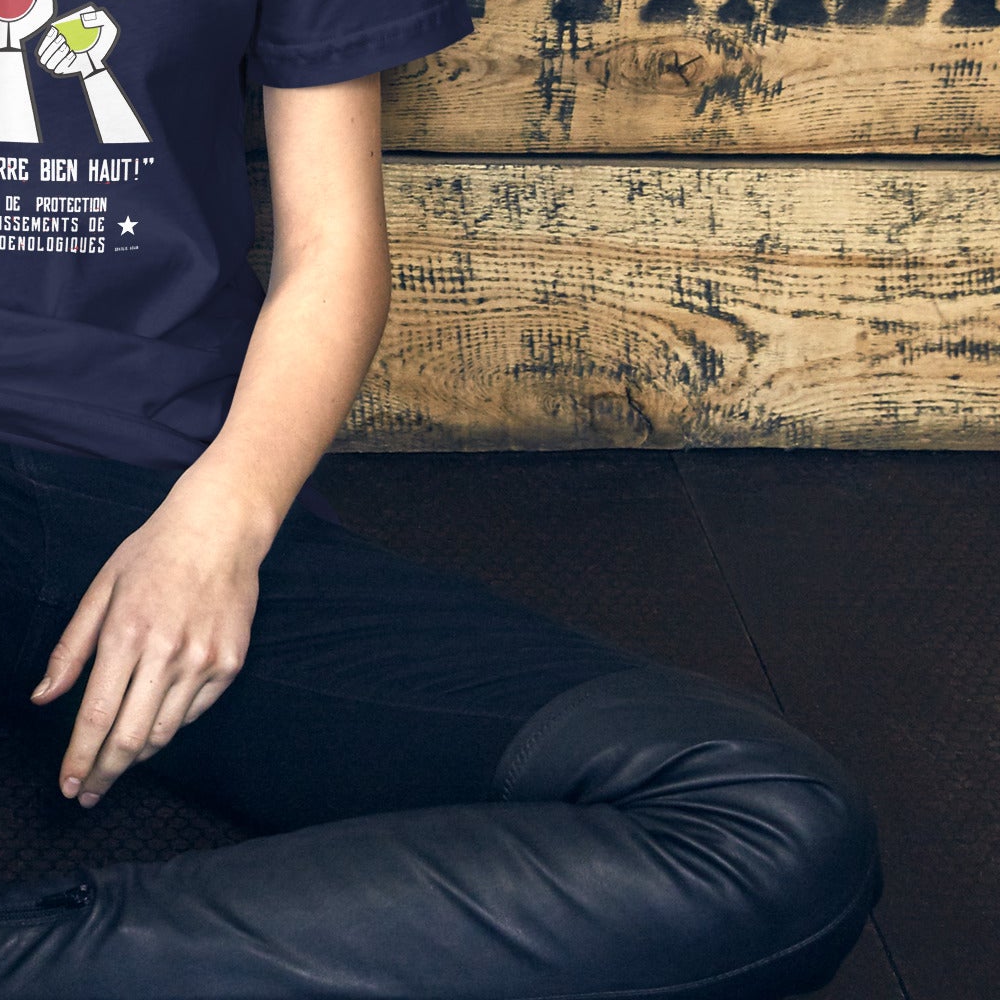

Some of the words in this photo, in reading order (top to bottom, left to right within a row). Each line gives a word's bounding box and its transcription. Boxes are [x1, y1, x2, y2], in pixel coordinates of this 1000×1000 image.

[39, 158, 78, 182] BIEN
[5, 195, 21, 212] DE
[35, 196, 108, 213] PROTECTION
[88, 216, 105, 233] DE
